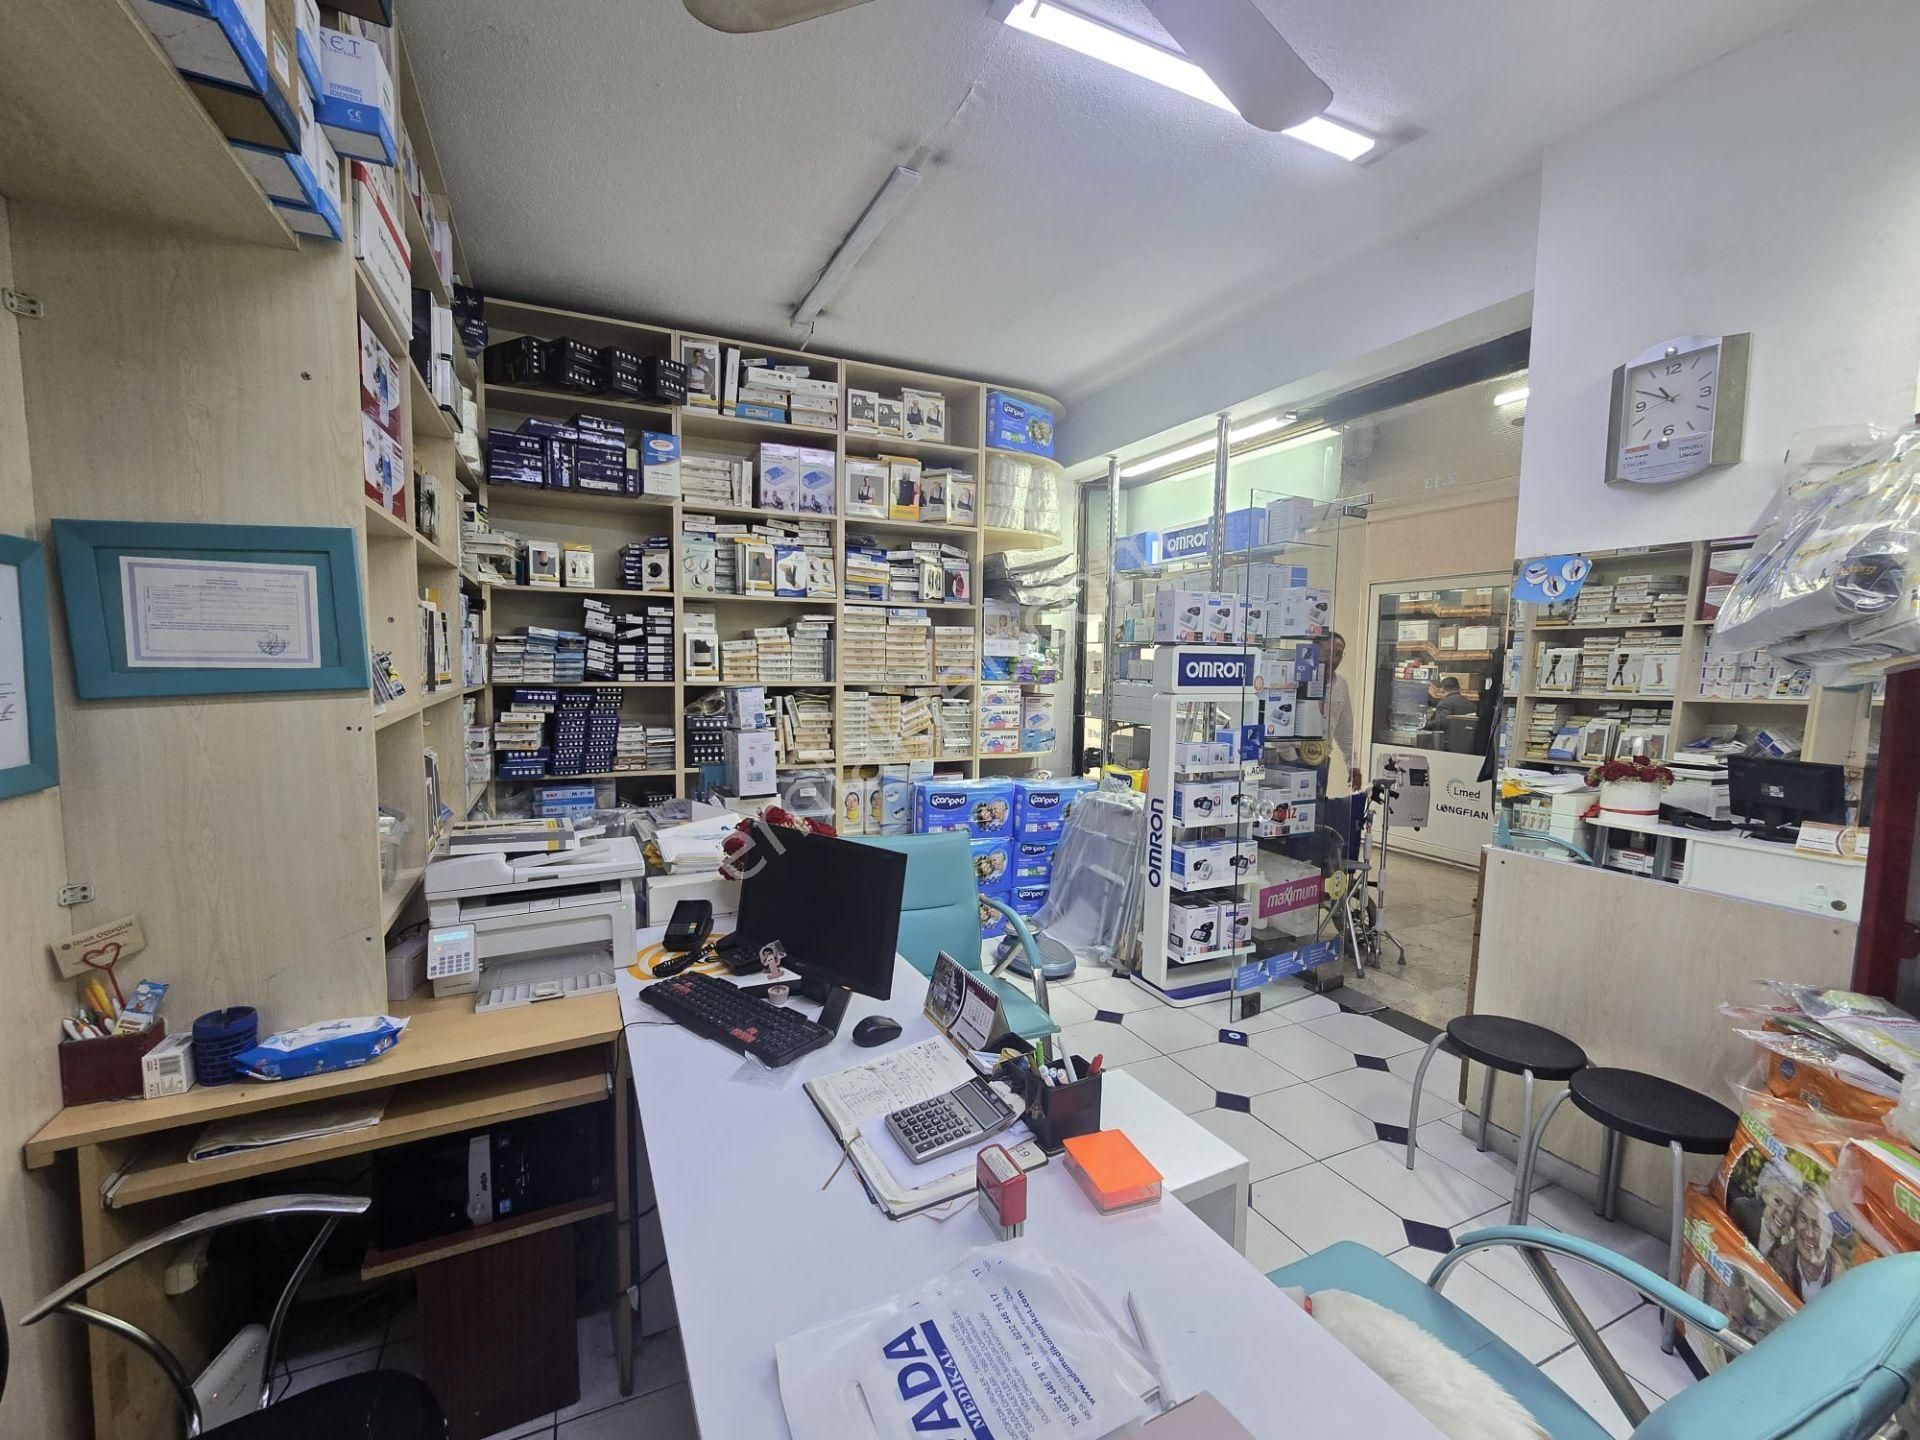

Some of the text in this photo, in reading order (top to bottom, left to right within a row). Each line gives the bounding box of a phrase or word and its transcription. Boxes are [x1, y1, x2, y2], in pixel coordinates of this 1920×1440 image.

[1664, 363, 1682, 376] 12
[1700, 386, 1712, 398] 3
[1636, 402, 1646, 412] 9
[1662, 424, 1674, 436] 6
[1168, 530, 1208, 551] OMRON
[1186, 661, 1247, 679] OMRON
[1454, 786, 1480, 799] Lmed
[1436, 802, 1489, 820] LONGFIAN
[1148, 798, 1164, 888] OMRON
[1267, 882, 1319, 908] maximum
[990, 1292, 1000, 1303] 17
[1014, 1289, 1097, 1407] www.adamedikalmarket.com
[882, 1326, 962, 1432] ADA
[936, 1347, 986, 1431] MEDİKAL
[1044, 1380, 1058, 1397] 446
[1053, 1395, 1070, 1414] 0232
[1065, 1411, 1080, 1427] Tel:
